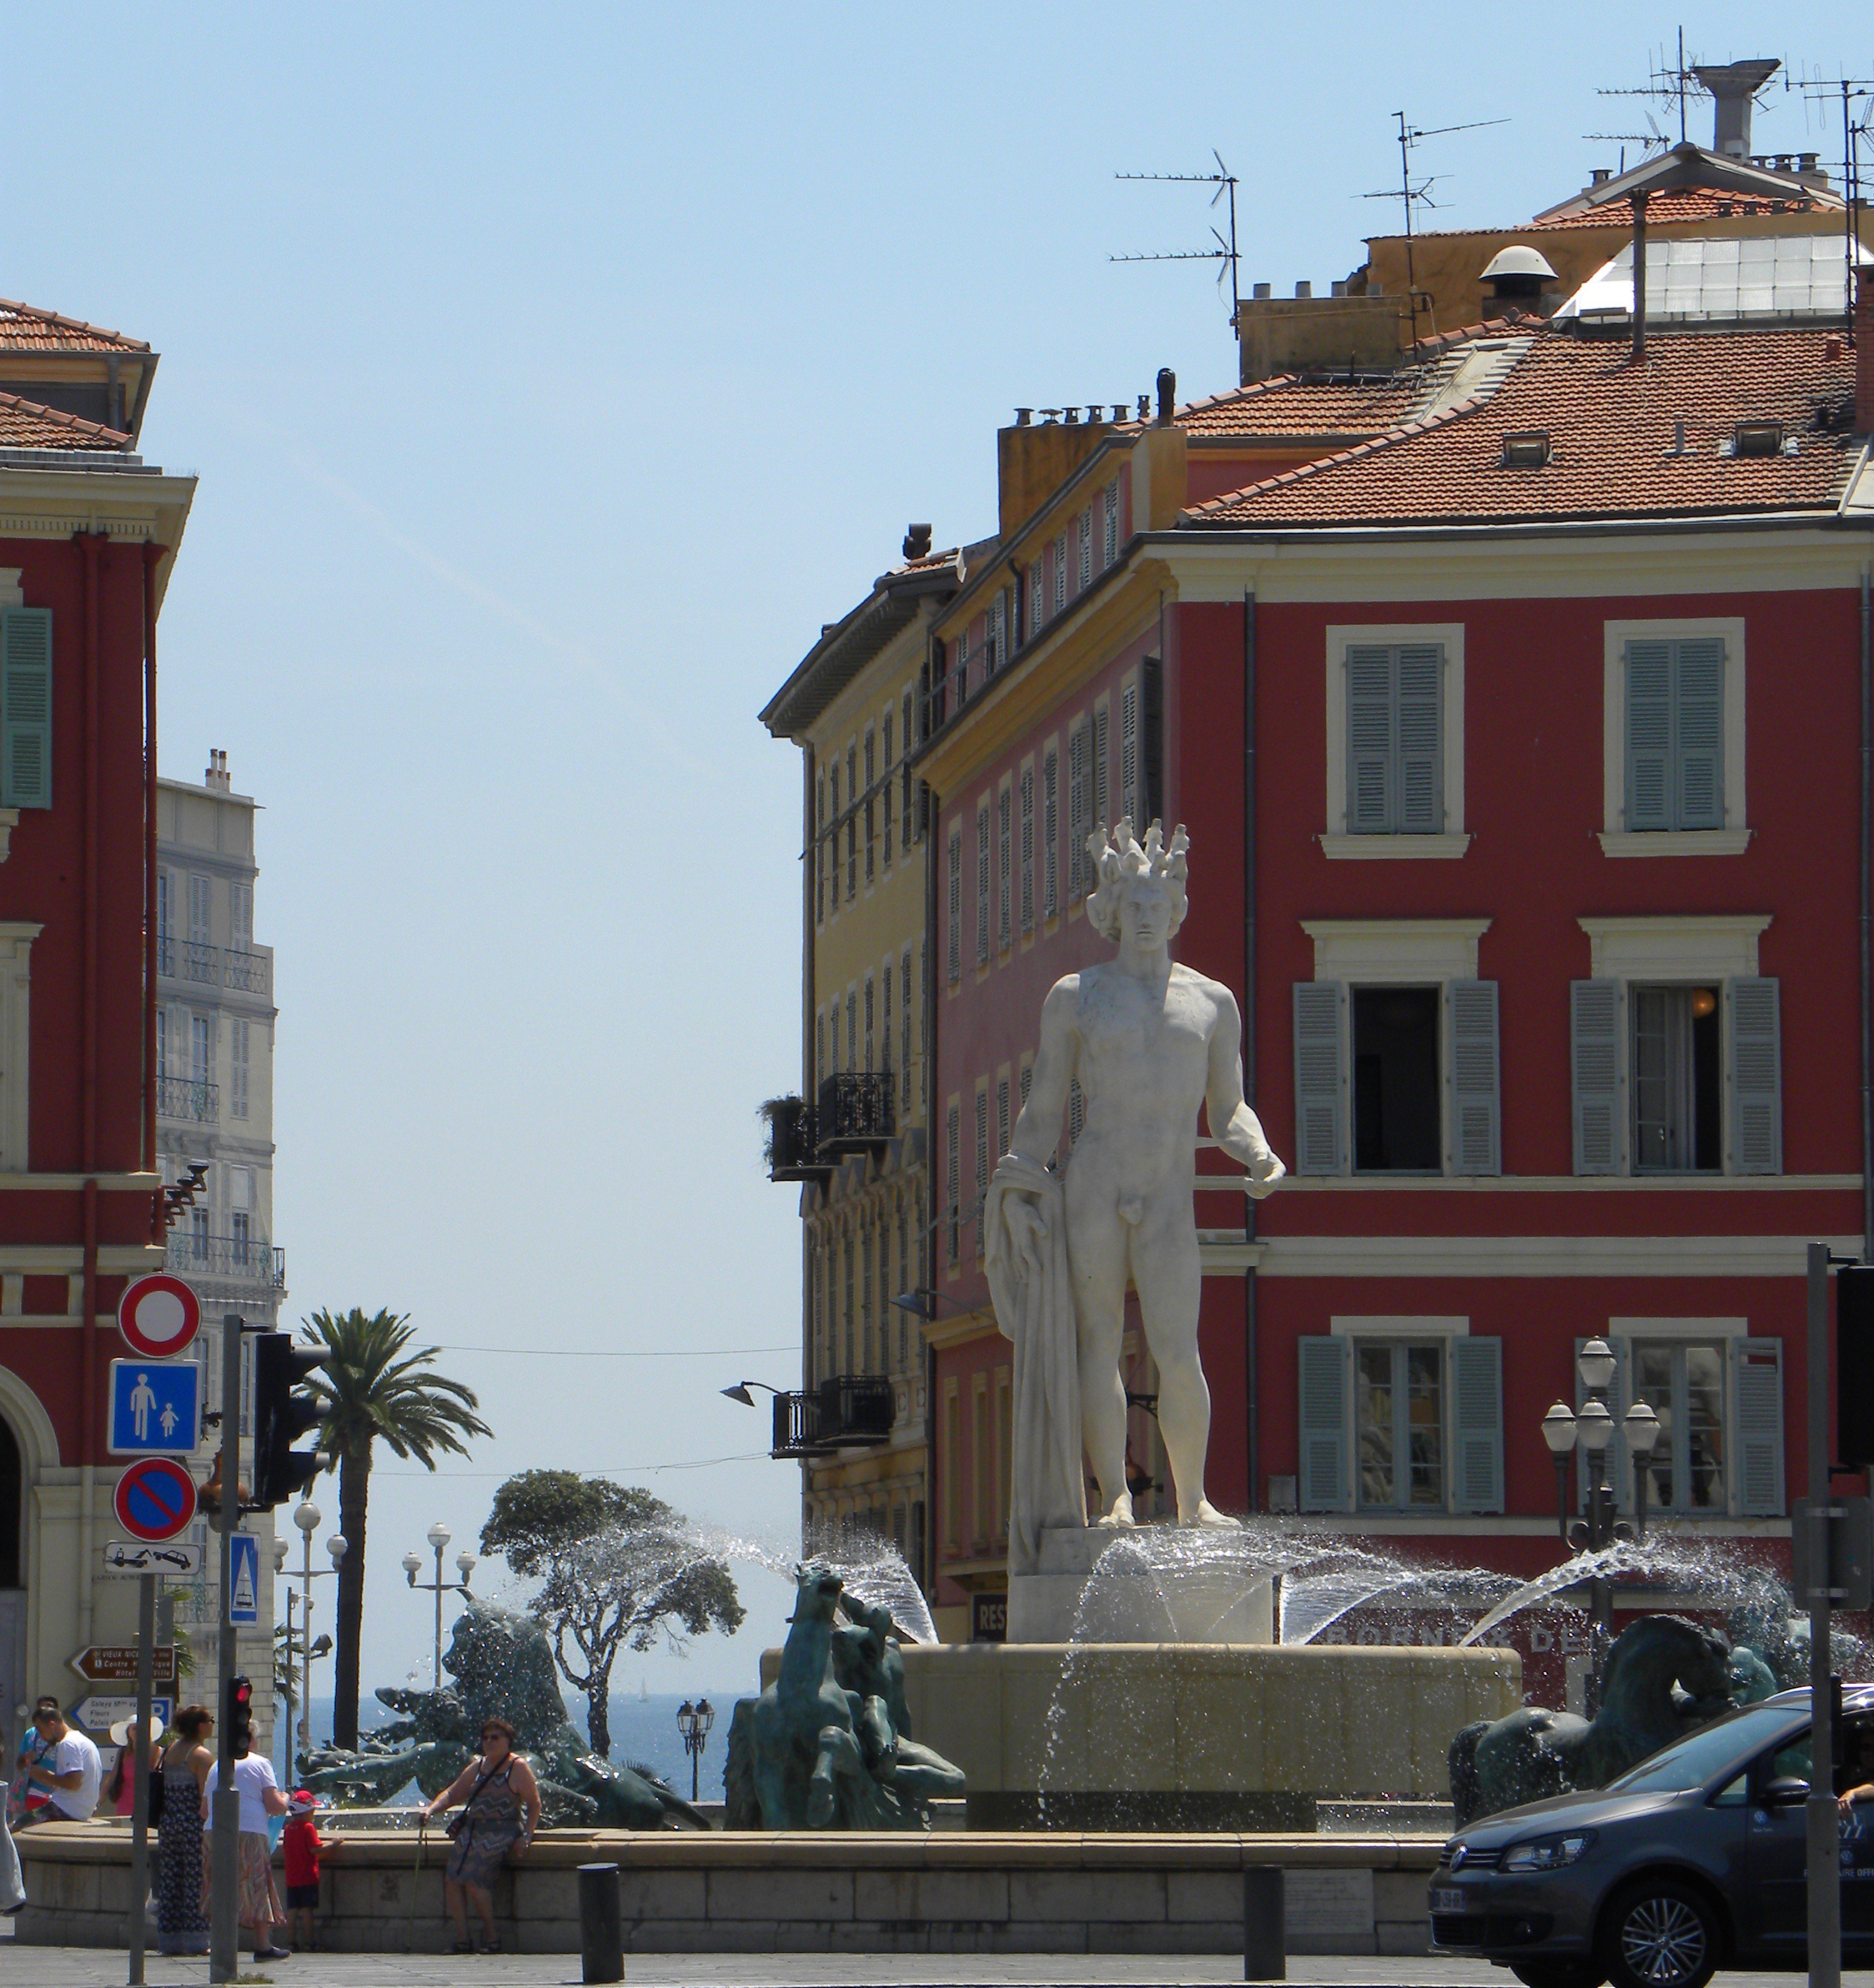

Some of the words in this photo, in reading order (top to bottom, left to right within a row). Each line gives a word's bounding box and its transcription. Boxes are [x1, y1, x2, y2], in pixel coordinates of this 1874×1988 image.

[979, 1604, 1006, 1630] RES
[1530, 1626, 1582, 1653] DE
[1857, 1868, 1874, 1877] OFFI
